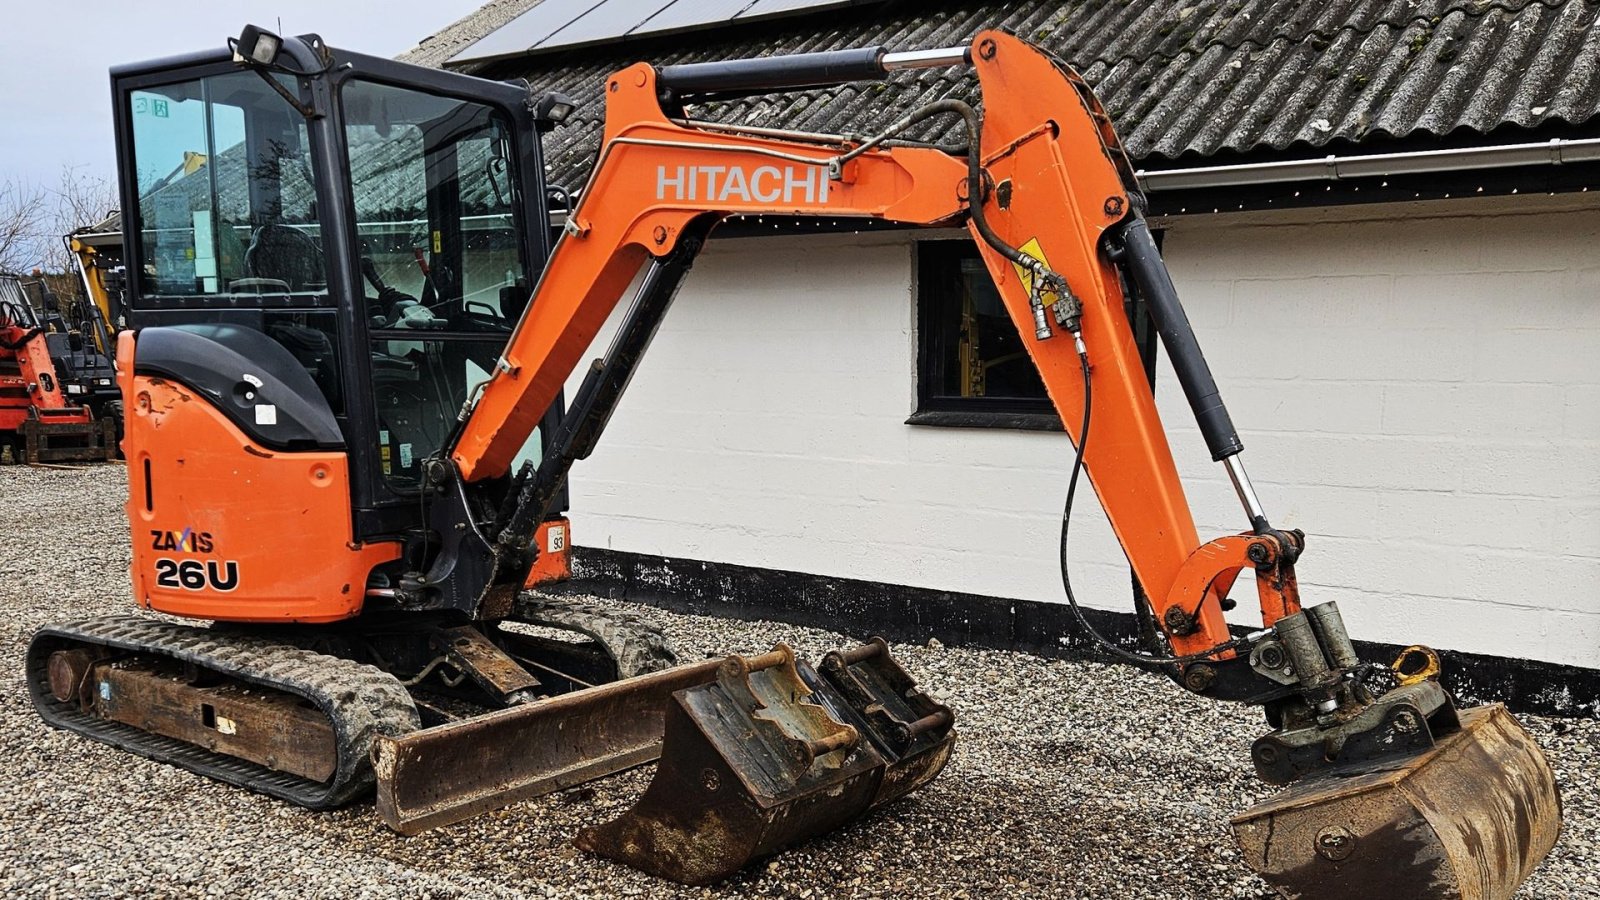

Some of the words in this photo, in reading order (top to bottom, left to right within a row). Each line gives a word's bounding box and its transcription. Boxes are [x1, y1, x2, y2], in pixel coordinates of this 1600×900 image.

[656, 165, 831, 204] HITACHI
[150, 527, 214, 553] ZAXIS
[553, 537, 564, 550] 93
[155, 558, 239, 592] 26U
